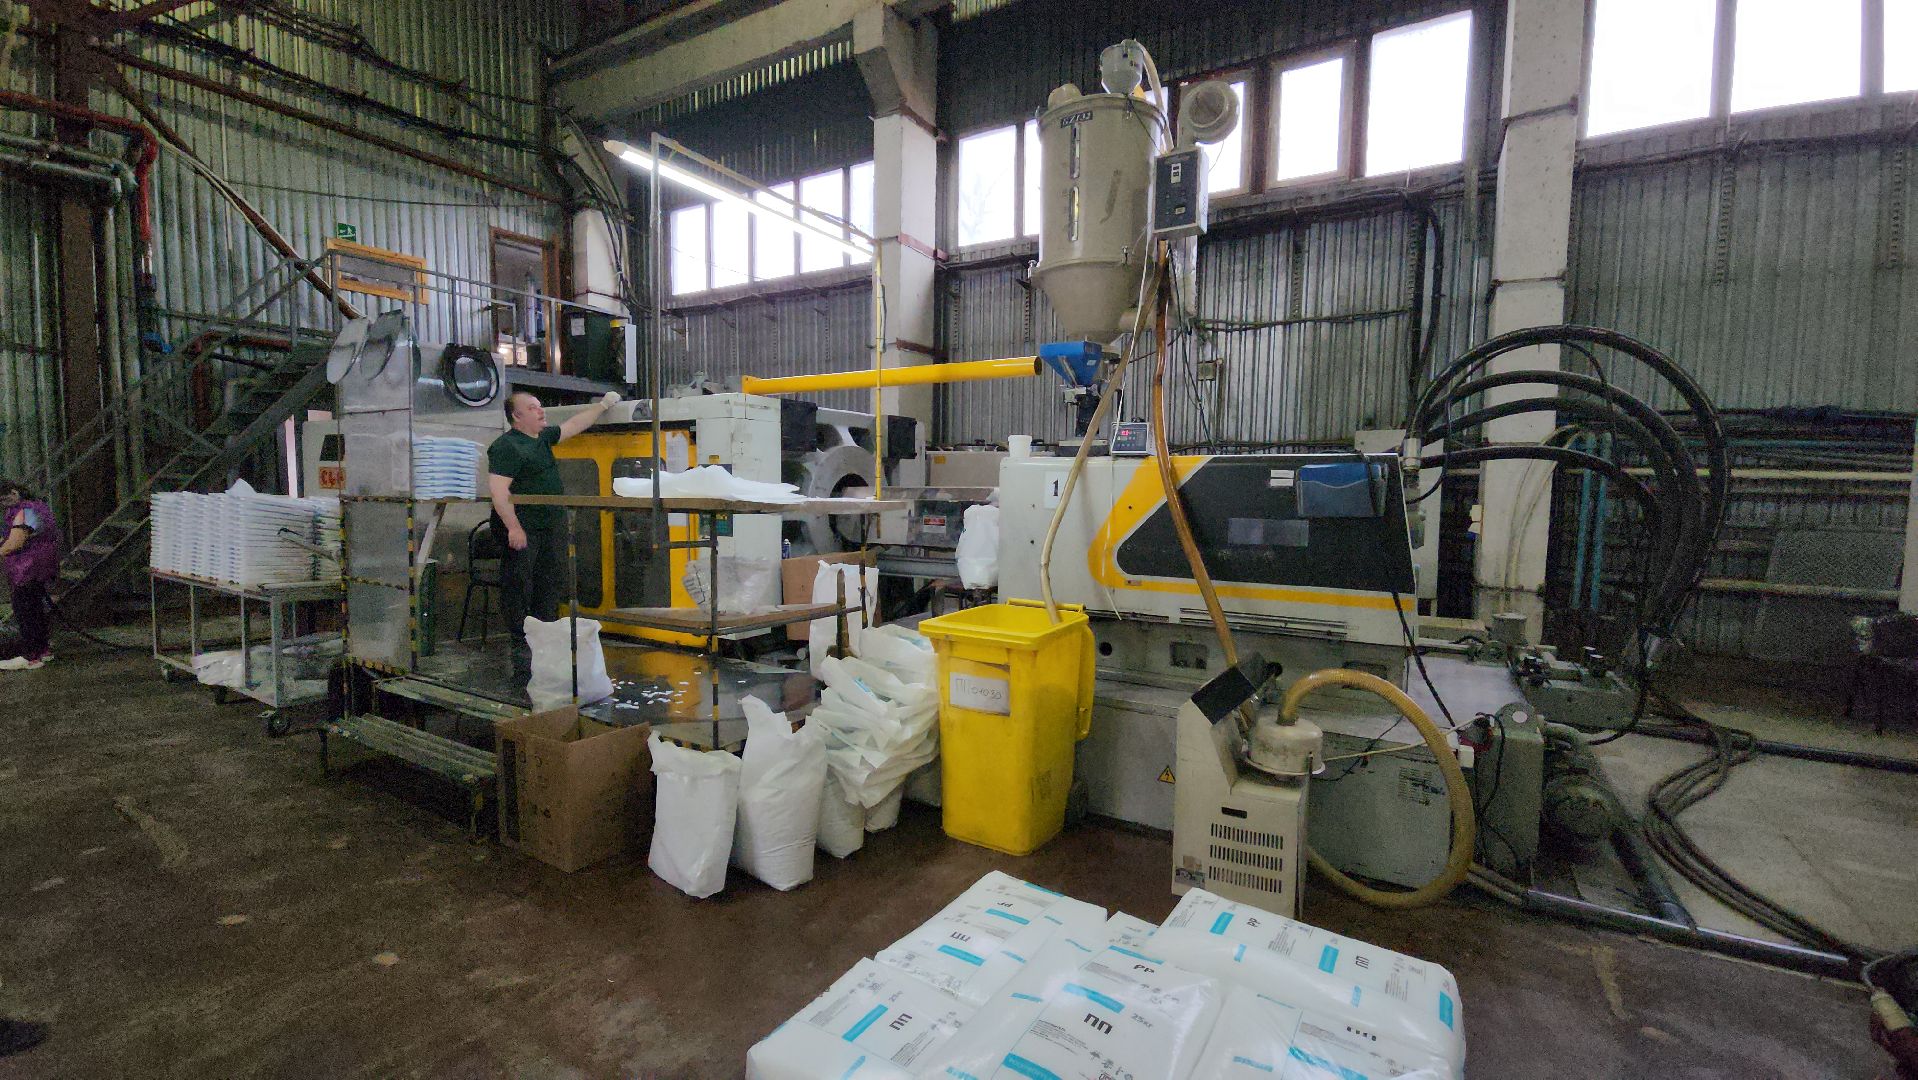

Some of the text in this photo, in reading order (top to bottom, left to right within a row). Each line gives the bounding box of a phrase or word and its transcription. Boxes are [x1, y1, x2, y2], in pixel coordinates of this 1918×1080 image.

[1053, 478, 1059, 497] 1
[889, 1012, 913, 1031] ПП
[1083, 1012, 1113, 1036] ПП
